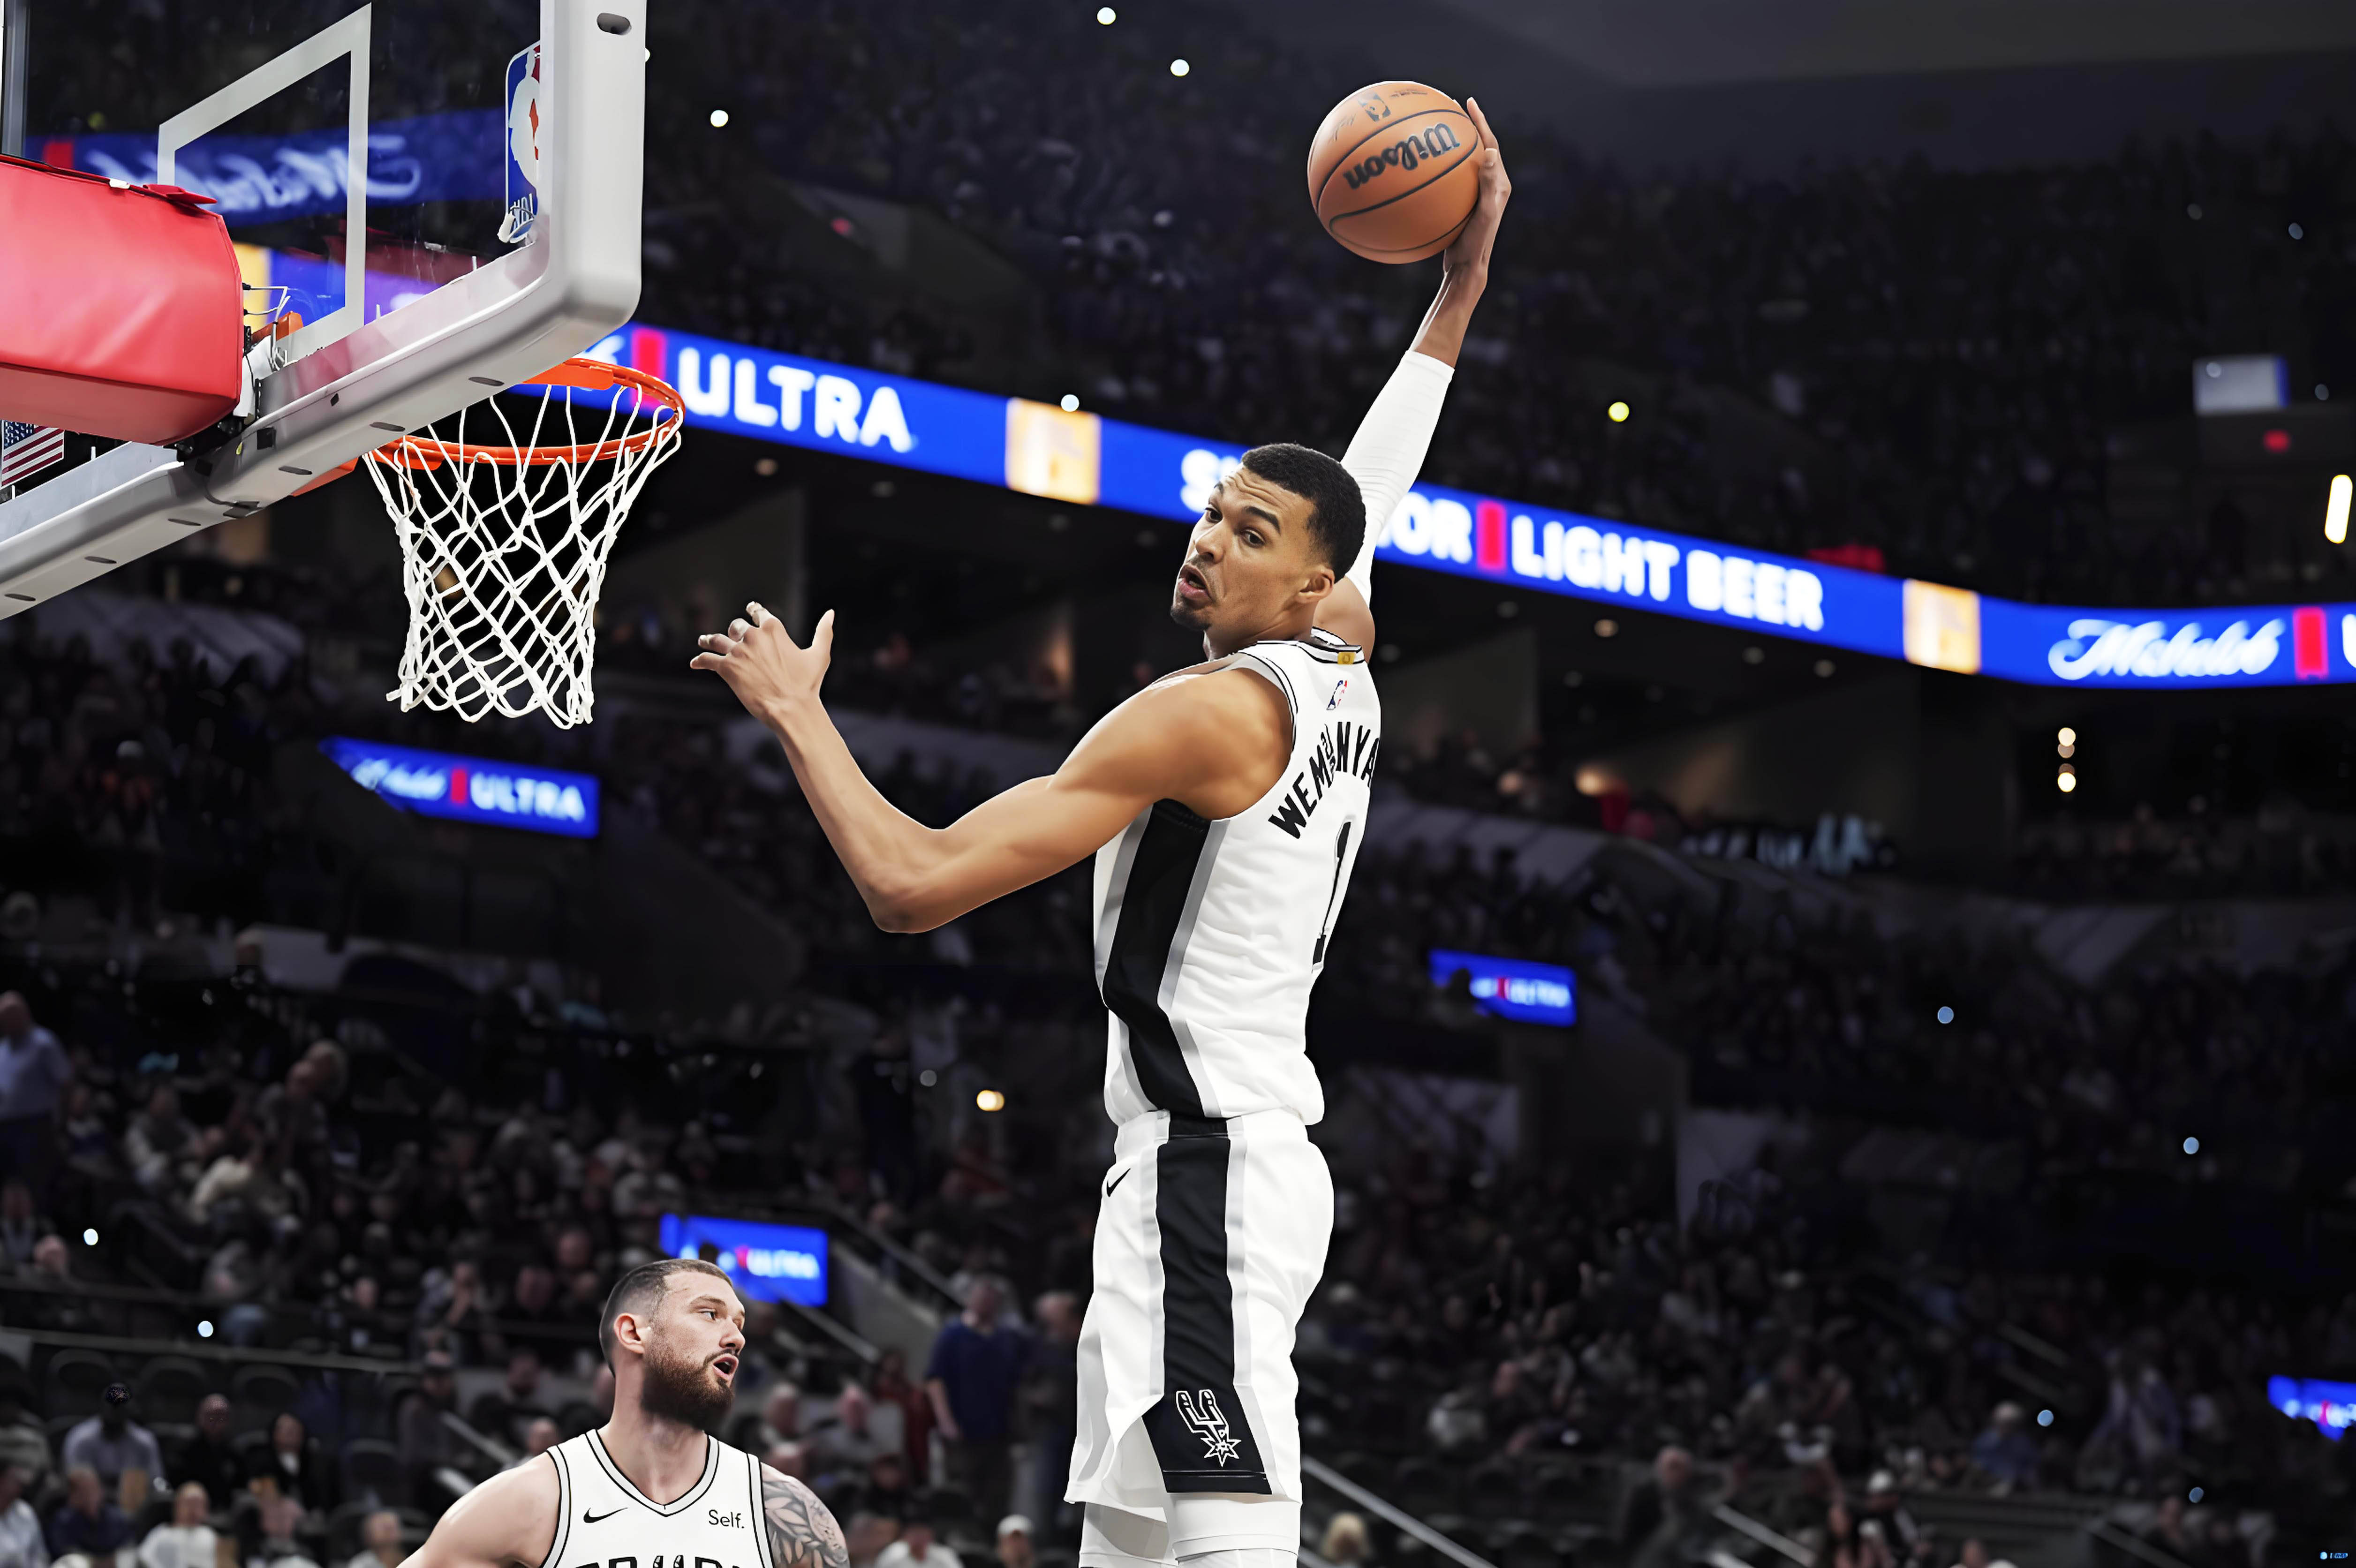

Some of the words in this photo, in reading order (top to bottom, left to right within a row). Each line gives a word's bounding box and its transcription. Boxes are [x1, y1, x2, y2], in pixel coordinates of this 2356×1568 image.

[1343, 122, 1460, 190] Wilson
[678, 347, 917, 453] ULTRA
[1511, 514, 1680, 602] LIGHT
[1686, 550, 1824, 632] BEER
[471, 772, 585, 822] ULTRA
[709, 1509, 745, 1529] Self.
